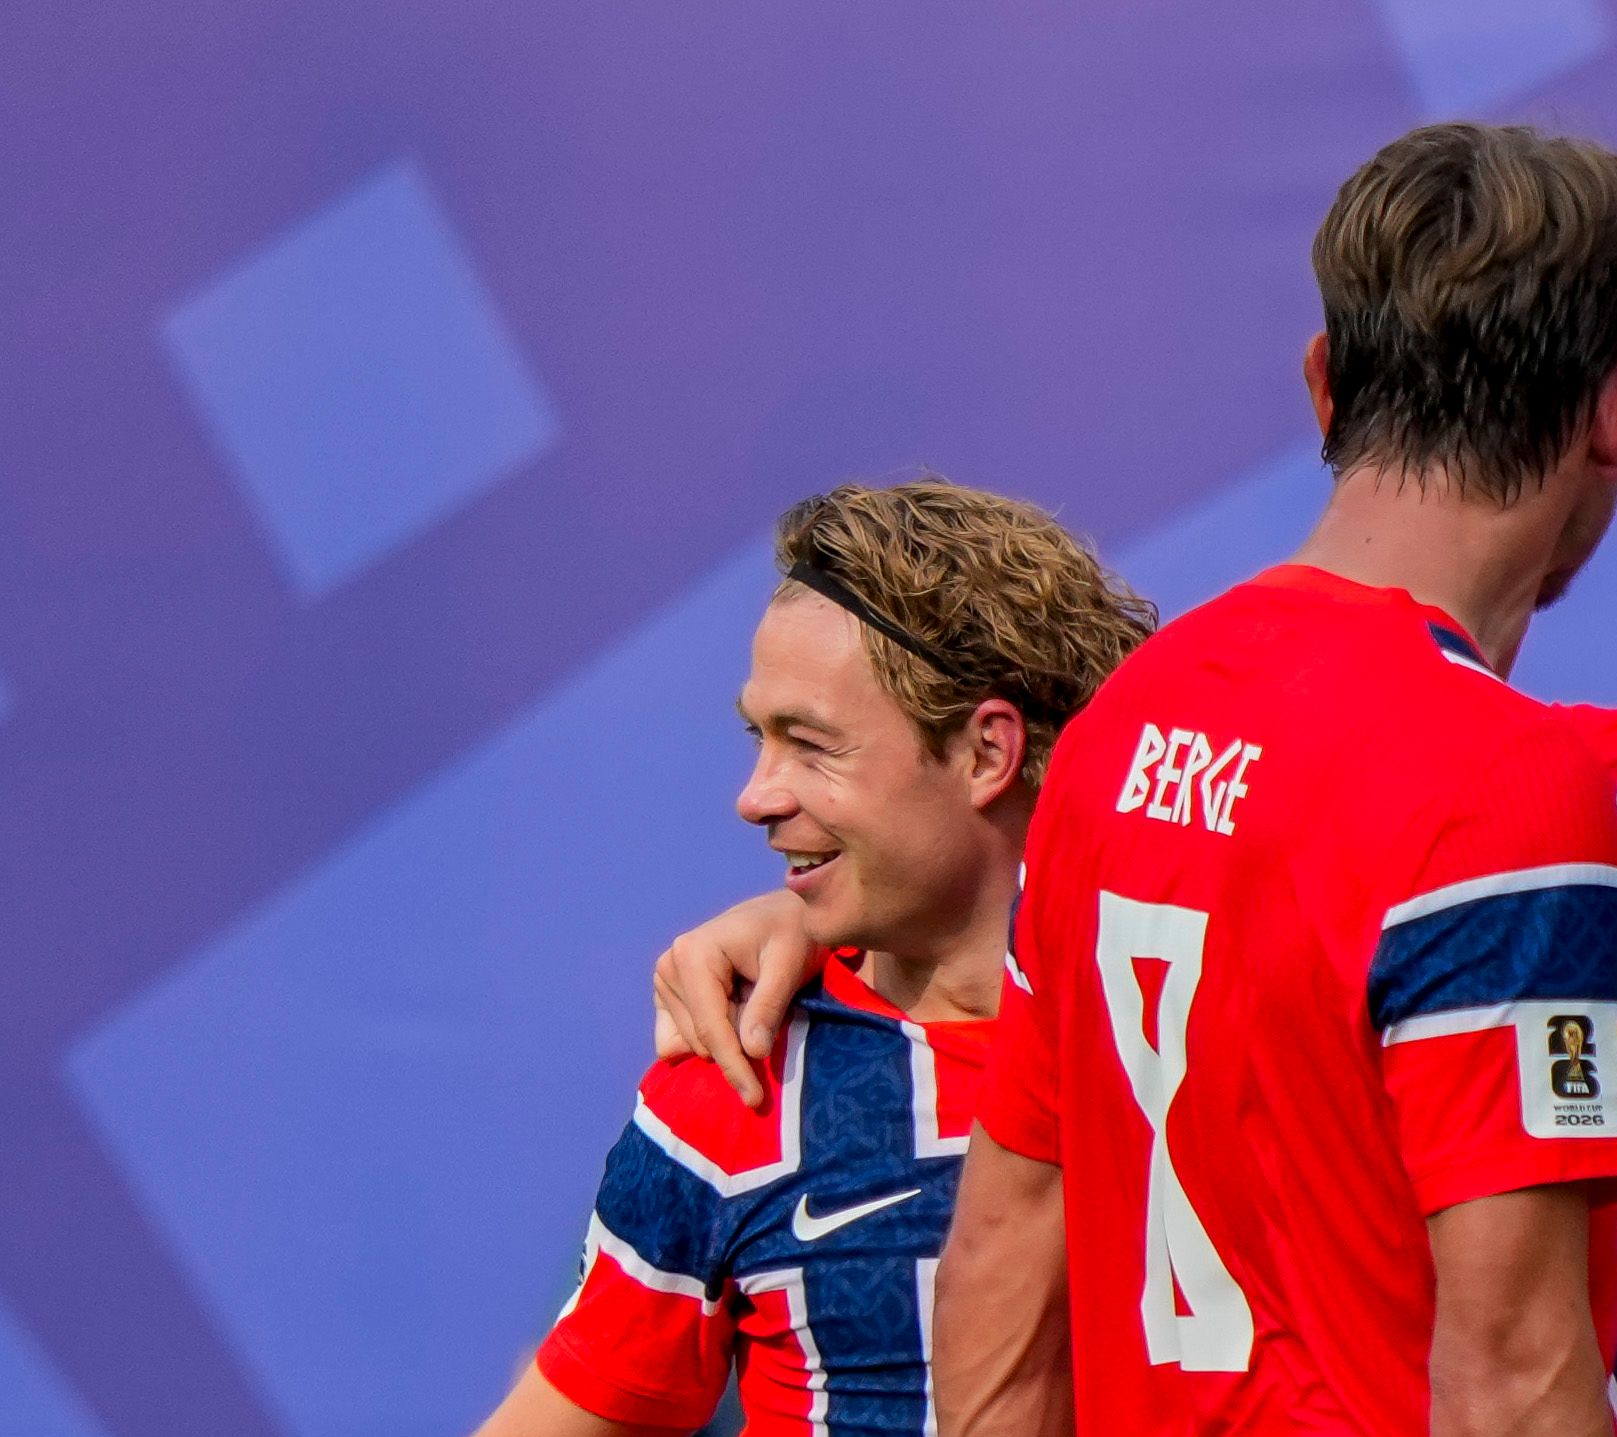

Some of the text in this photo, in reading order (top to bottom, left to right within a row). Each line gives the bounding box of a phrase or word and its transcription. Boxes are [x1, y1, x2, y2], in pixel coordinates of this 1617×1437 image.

[1116, 722, 1262, 836] BERGE
[1096, 889, 1255, 1372] 8
[1555, 1114, 1605, 1126] 2026
